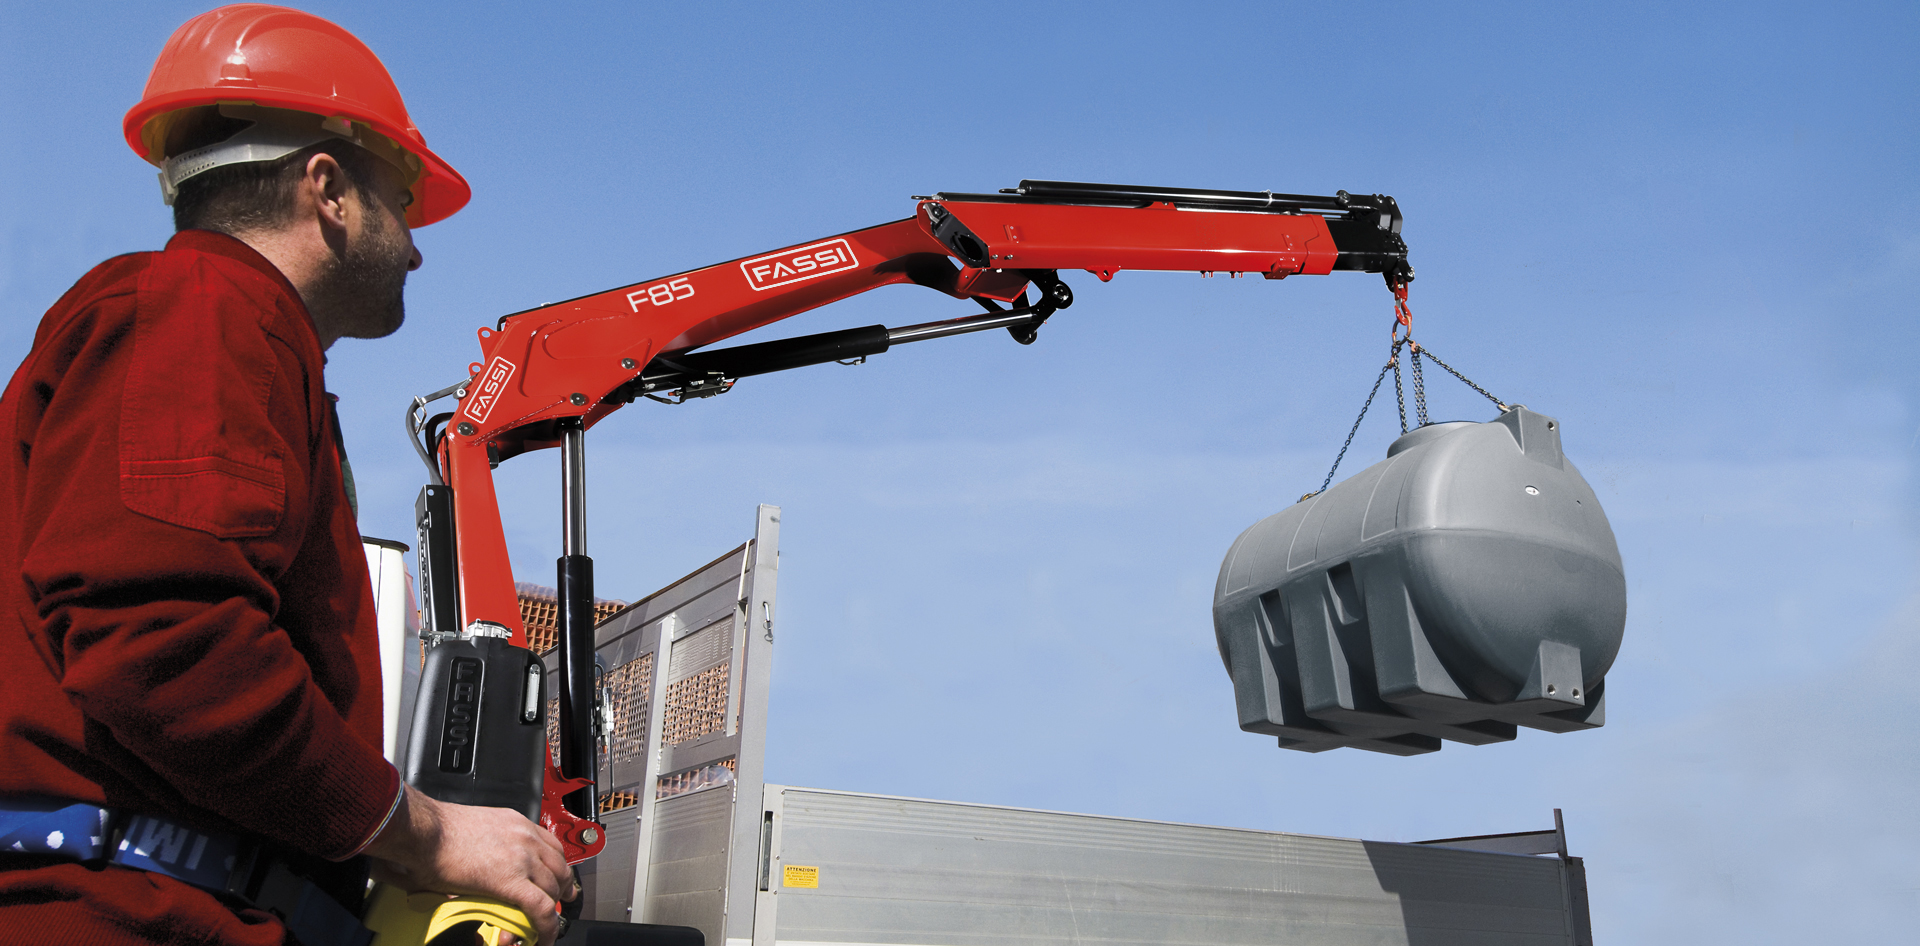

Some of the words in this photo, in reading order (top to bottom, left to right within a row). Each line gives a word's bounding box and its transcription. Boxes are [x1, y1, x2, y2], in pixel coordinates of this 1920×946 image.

[752, 247, 848, 282] FASSI
[626, 277, 695, 313] F85
[471, 363, 509, 417] FASSI
[447, 662, 477, 769] FASSI
